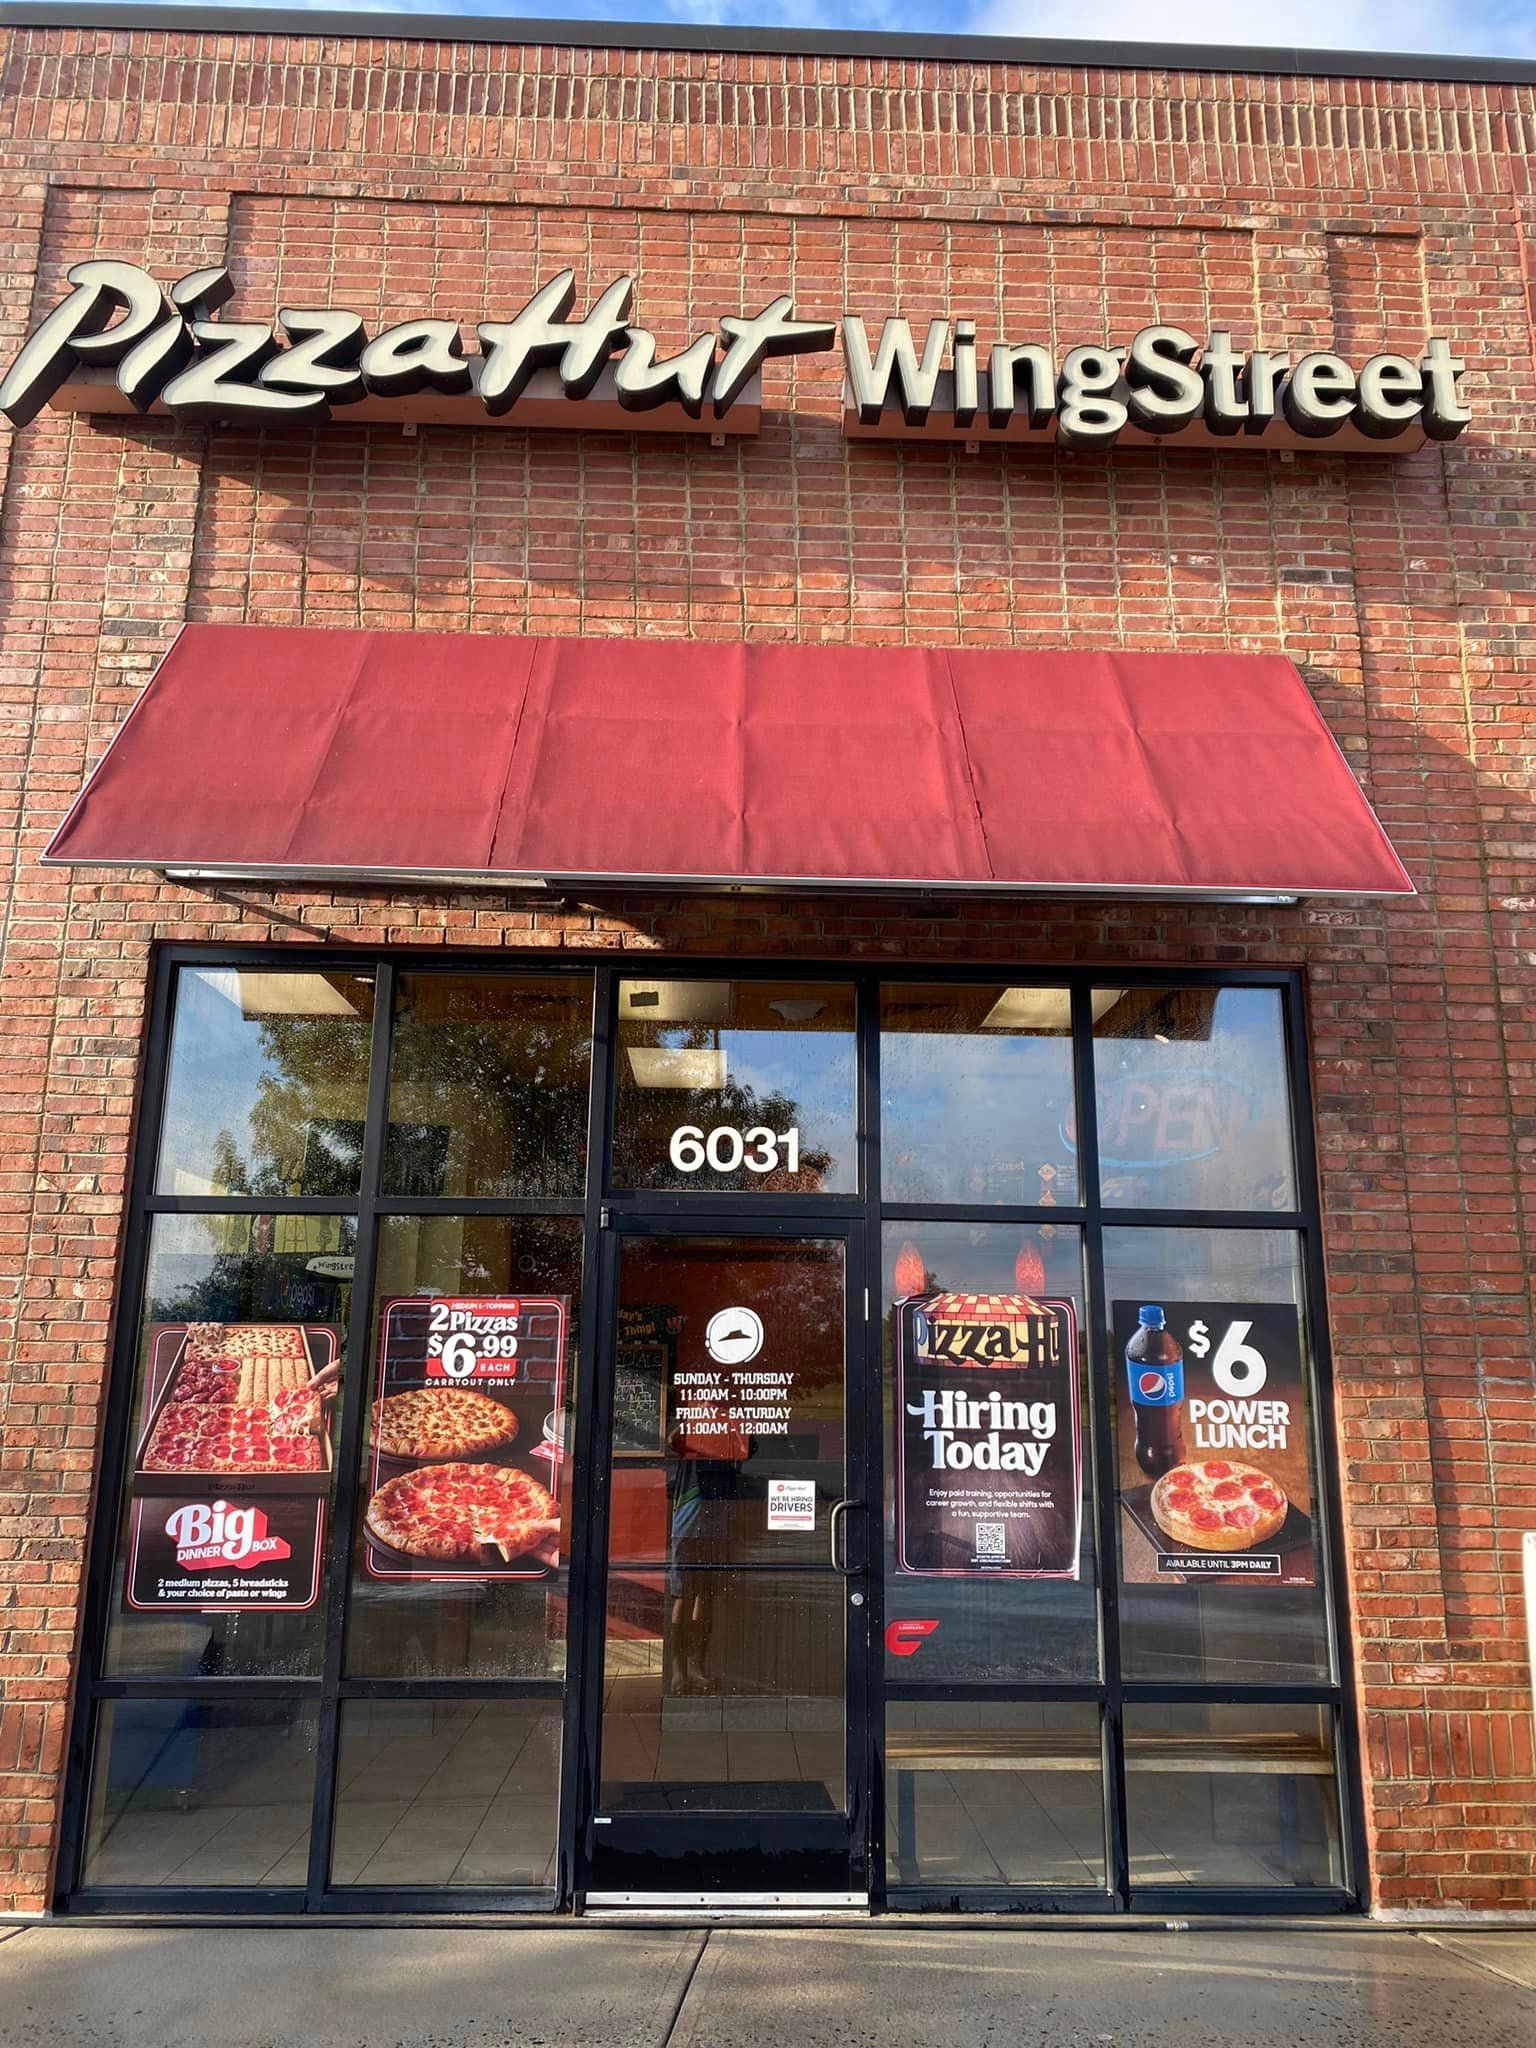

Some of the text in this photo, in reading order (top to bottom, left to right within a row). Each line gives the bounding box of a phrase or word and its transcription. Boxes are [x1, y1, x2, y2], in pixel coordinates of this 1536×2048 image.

[0, 258, 834, 430] Pizza Hut
[841, 314, 1474, 450] WingStreet
[669, 1125, 799, 1174] 6031
[429, 1303, 518, 1335] 2 Pizzas
[427, 1332, 518, 1378] $6.99
[1188, 1320, 1267, 1398] $6
[480, 1363, 511, 1372] EACH
[425, 1378, 516, 1386] CARRYOUT ONLY
[673, 1373, 721, 1385] SUNDAY
[732, 1373, 794, 1385] THURSDAY
[1167, 1373, 1176, 1398] pepsi
[680, 1389, 729, 1401] 11:00AM
[740, 1389, 788, 1401] 10:00PM
[675, 1407, 719, 1419] FRIDAY
[729, 1407, 792, 1419] SATURDAY
[906, 1390, 1056, 1439] Hiring
[1189, 1400, 1291, 1425] POWER
[679, 1422, 728, 1434] 11:00AM
[740, 1422, 788, 1434] 12:00AM
[1195, 1424, 1287, 1449] LUNCH
[924, 1430, 1051, 1477] Today
[929, 1489, 947, 1498] Enjoy
[948, 1489, 964, 1498] paid
[994, 1490, 1040, 1499] opportunities
[770, 1502, 813, 1512] DRIVERS
[972, 1511, 1008, 1519] supportive
[165, 1500, 255, 1560] Big
[176, 1539, 277, 1561] DINNER BOX
[1165, 1559, 1272, 1568] AVAILABLE UNTIL 3PM DAILY
[158, 1578, 288, 1588] 2 medium pizzas, 5 breadsticks
[158, 1589, 165, 1597] &
[166, 1590, 186, 1598] your
[187, 1589, 215, 1597] choice
[216, 1589, 225, 1597] of
[225, 1589, 248, 1599] pasta
[261, 1589, 287, 1599] wings
